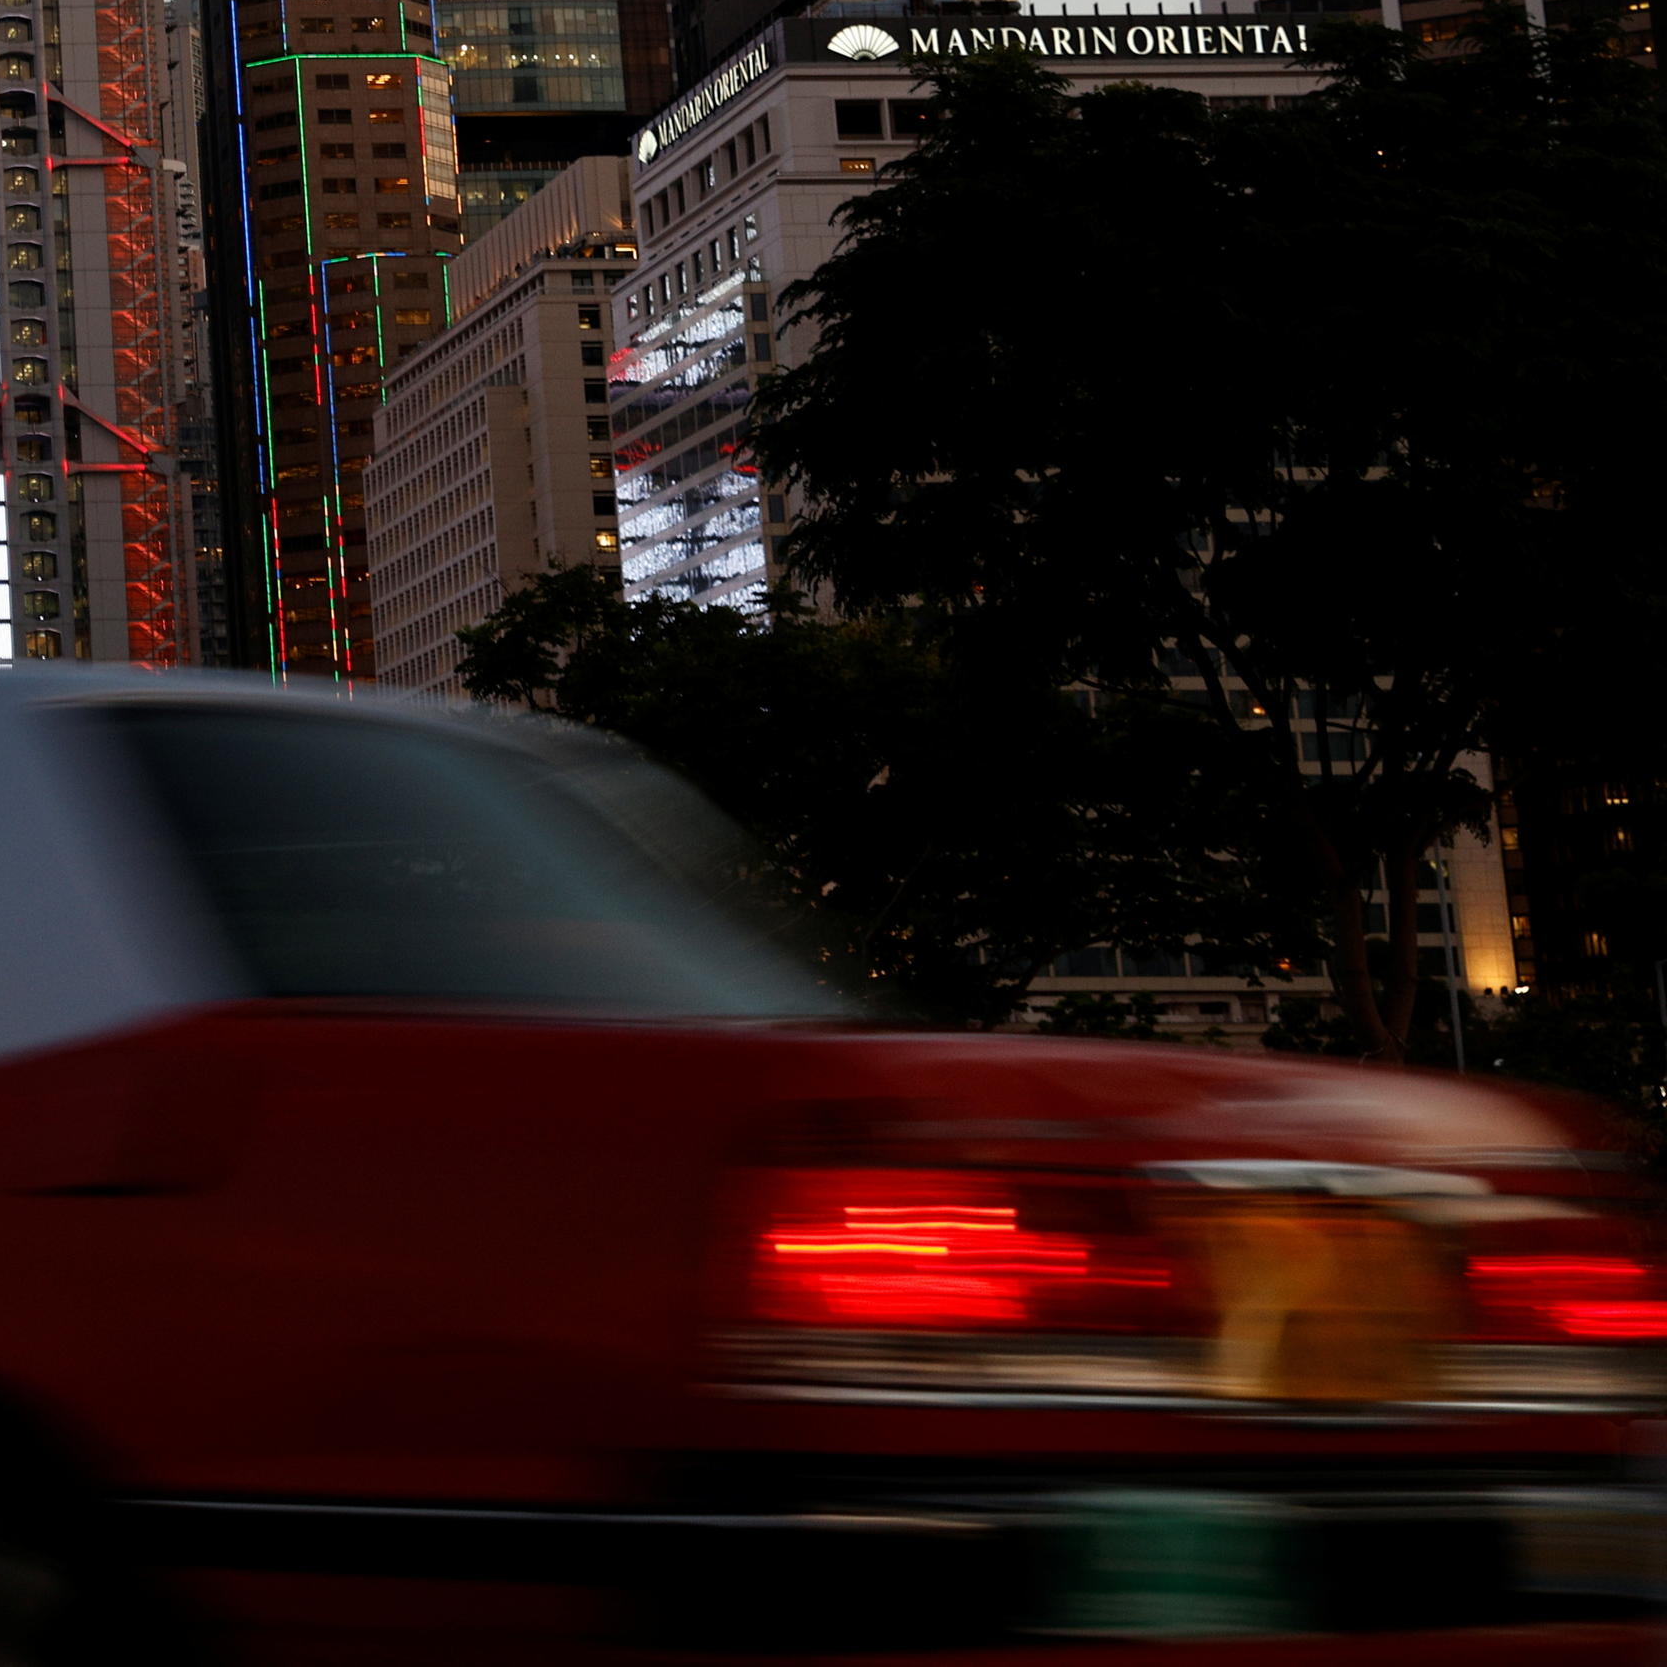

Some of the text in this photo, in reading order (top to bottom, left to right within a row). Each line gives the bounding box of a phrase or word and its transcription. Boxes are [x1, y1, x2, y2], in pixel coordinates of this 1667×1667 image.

[909, 23, 1313, 56] MANDARIN ORIENTAL
[657, 42, 770, 150] MANDARIN ORIENTAL
